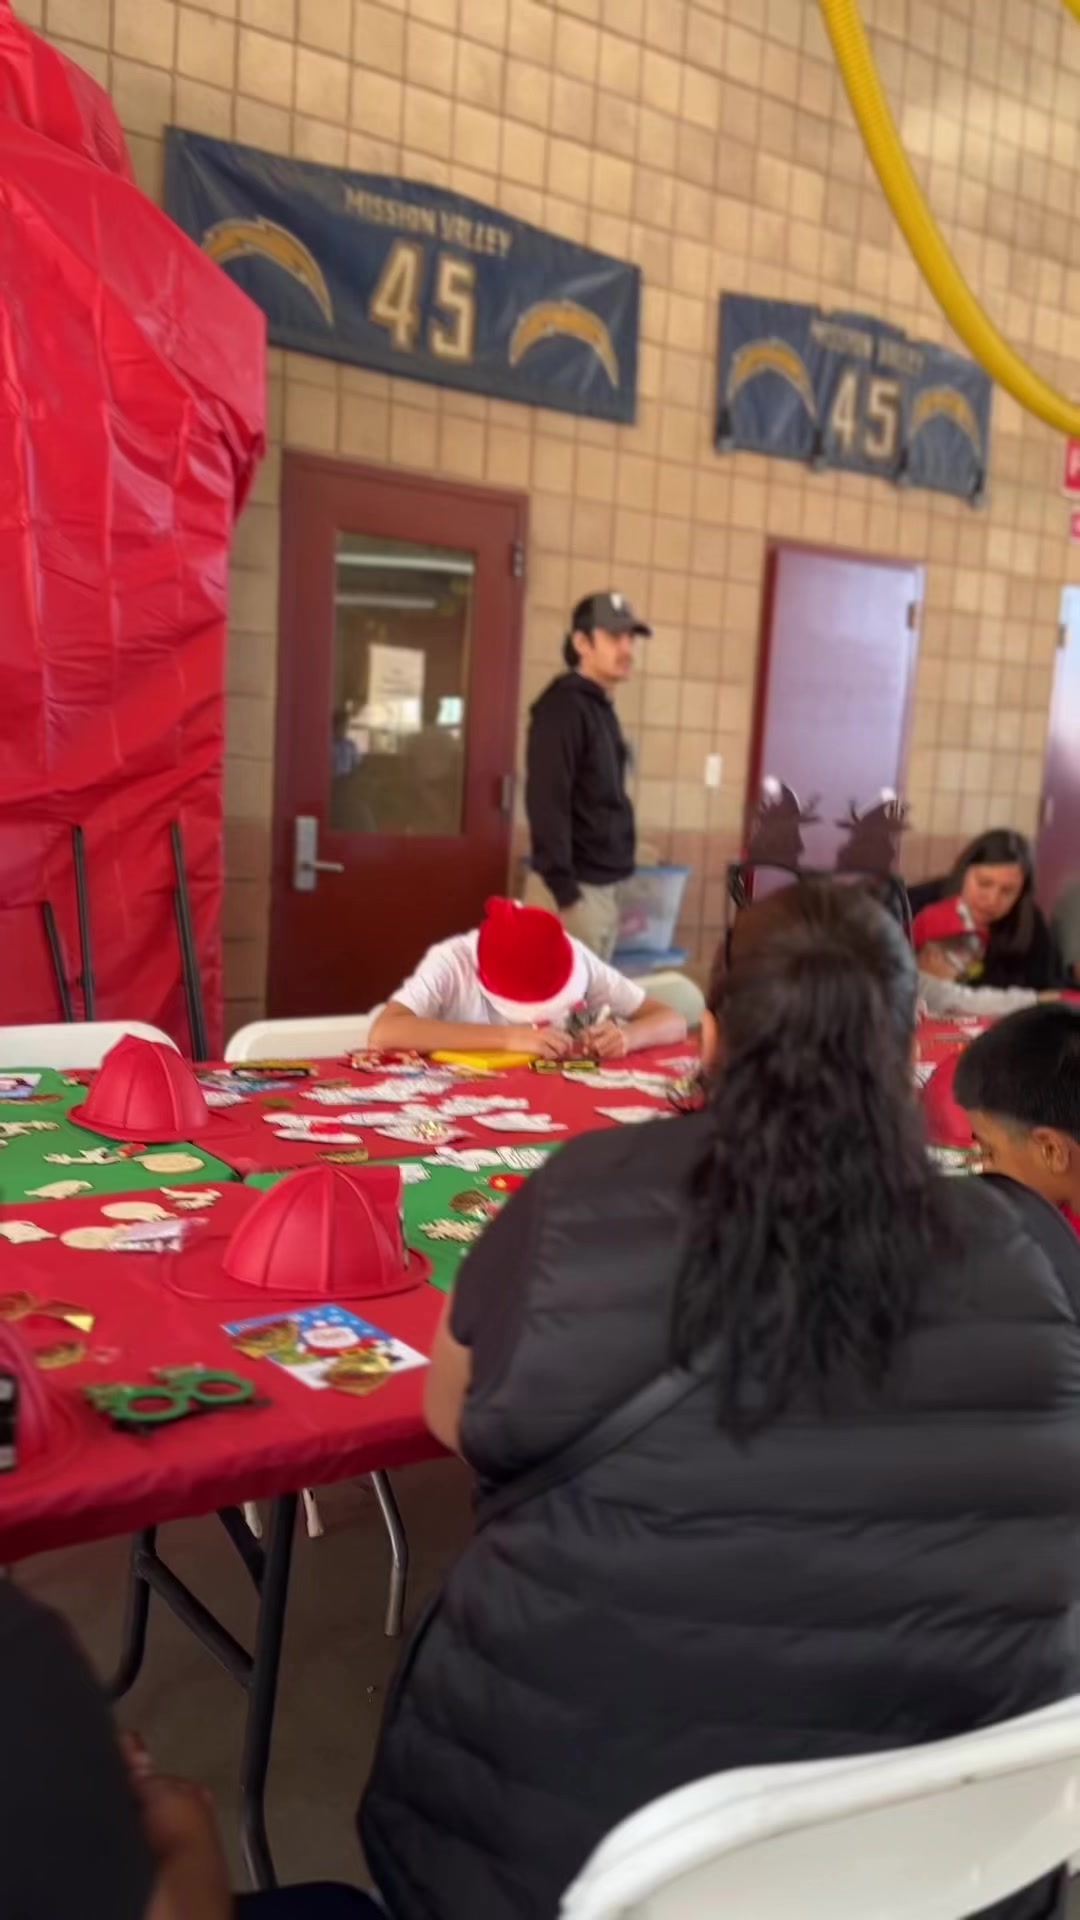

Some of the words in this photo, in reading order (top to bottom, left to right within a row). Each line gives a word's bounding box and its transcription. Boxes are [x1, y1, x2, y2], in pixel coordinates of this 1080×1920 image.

[344, 186, 436, 234] MISSION
[440, 211, 511, 258] VALLEY
[369, 238, 477, 363] 45
[830, 368, 900, 460] 45
